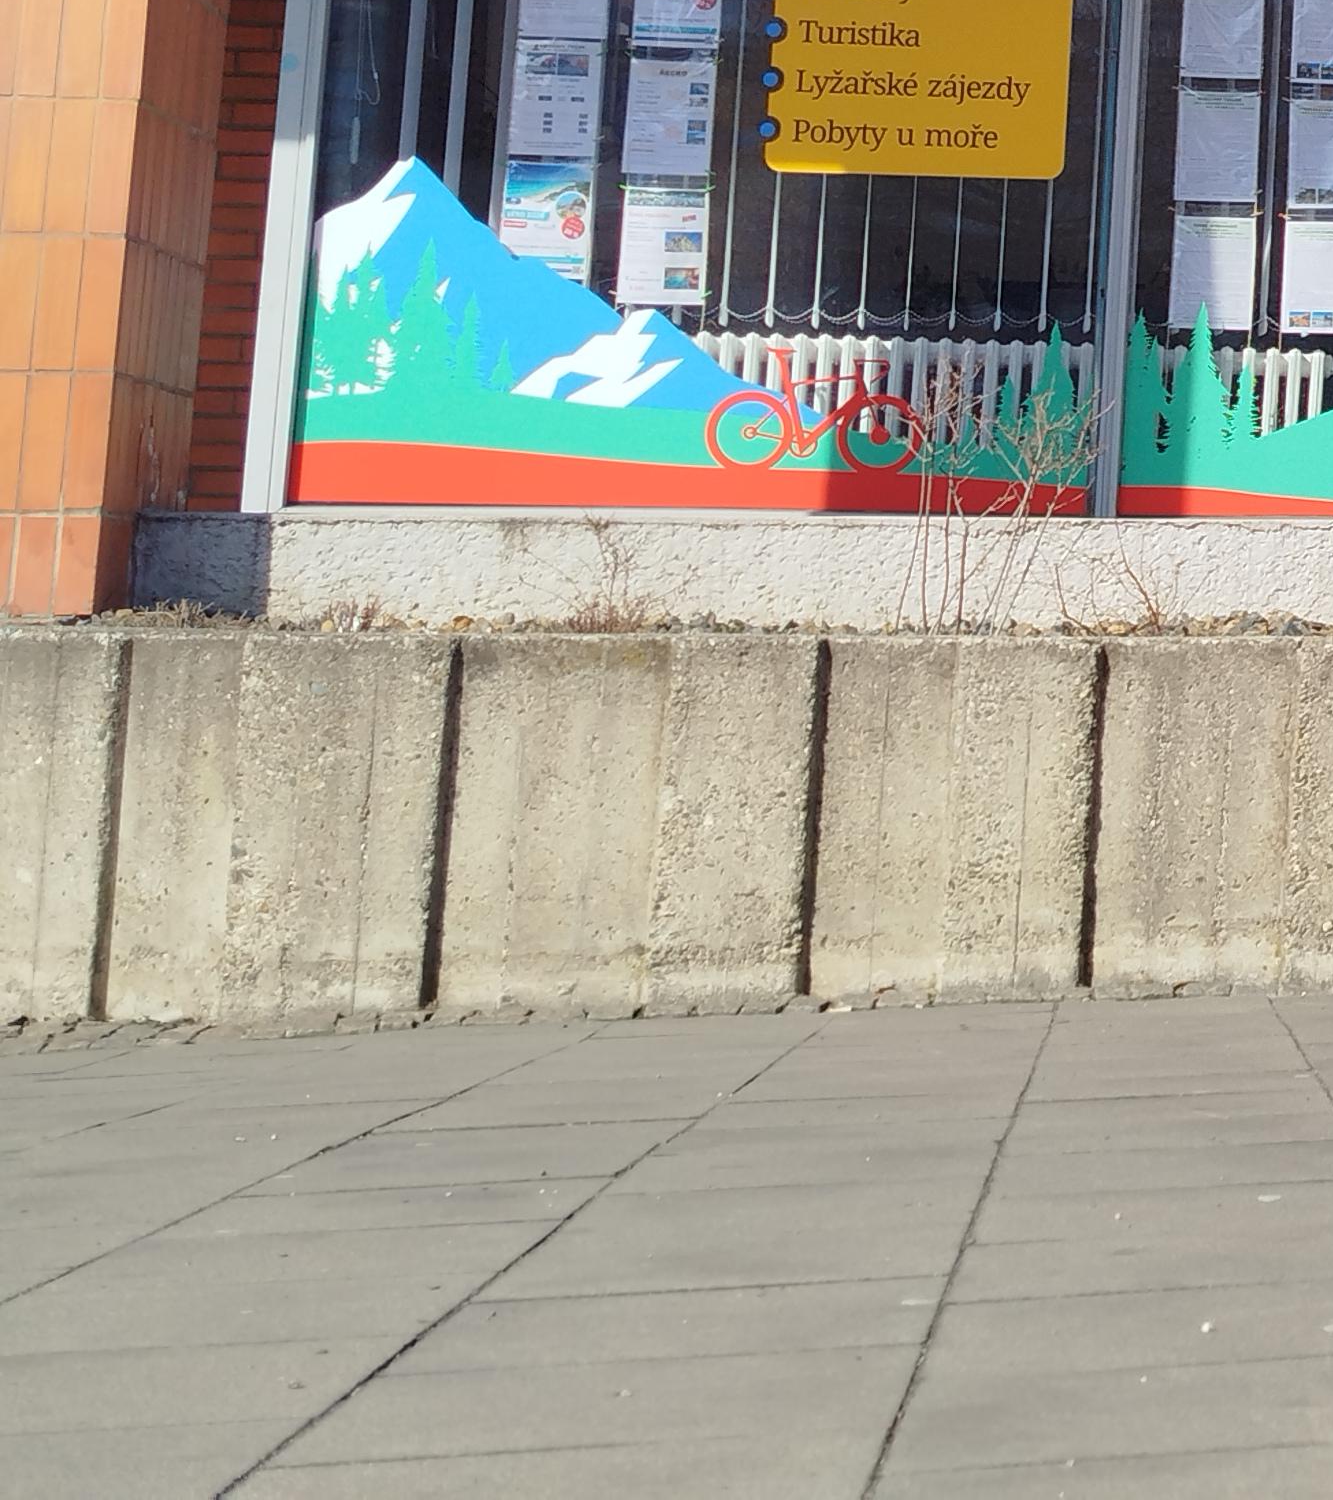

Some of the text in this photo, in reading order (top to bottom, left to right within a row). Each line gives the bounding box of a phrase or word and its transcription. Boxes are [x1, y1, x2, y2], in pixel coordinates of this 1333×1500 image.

[798, 19, 921, 48] Turistika
[795, 69, 1032, 108] Lyžařské zájezdy
[791, 118, 999, 152] Pobyty u moře
